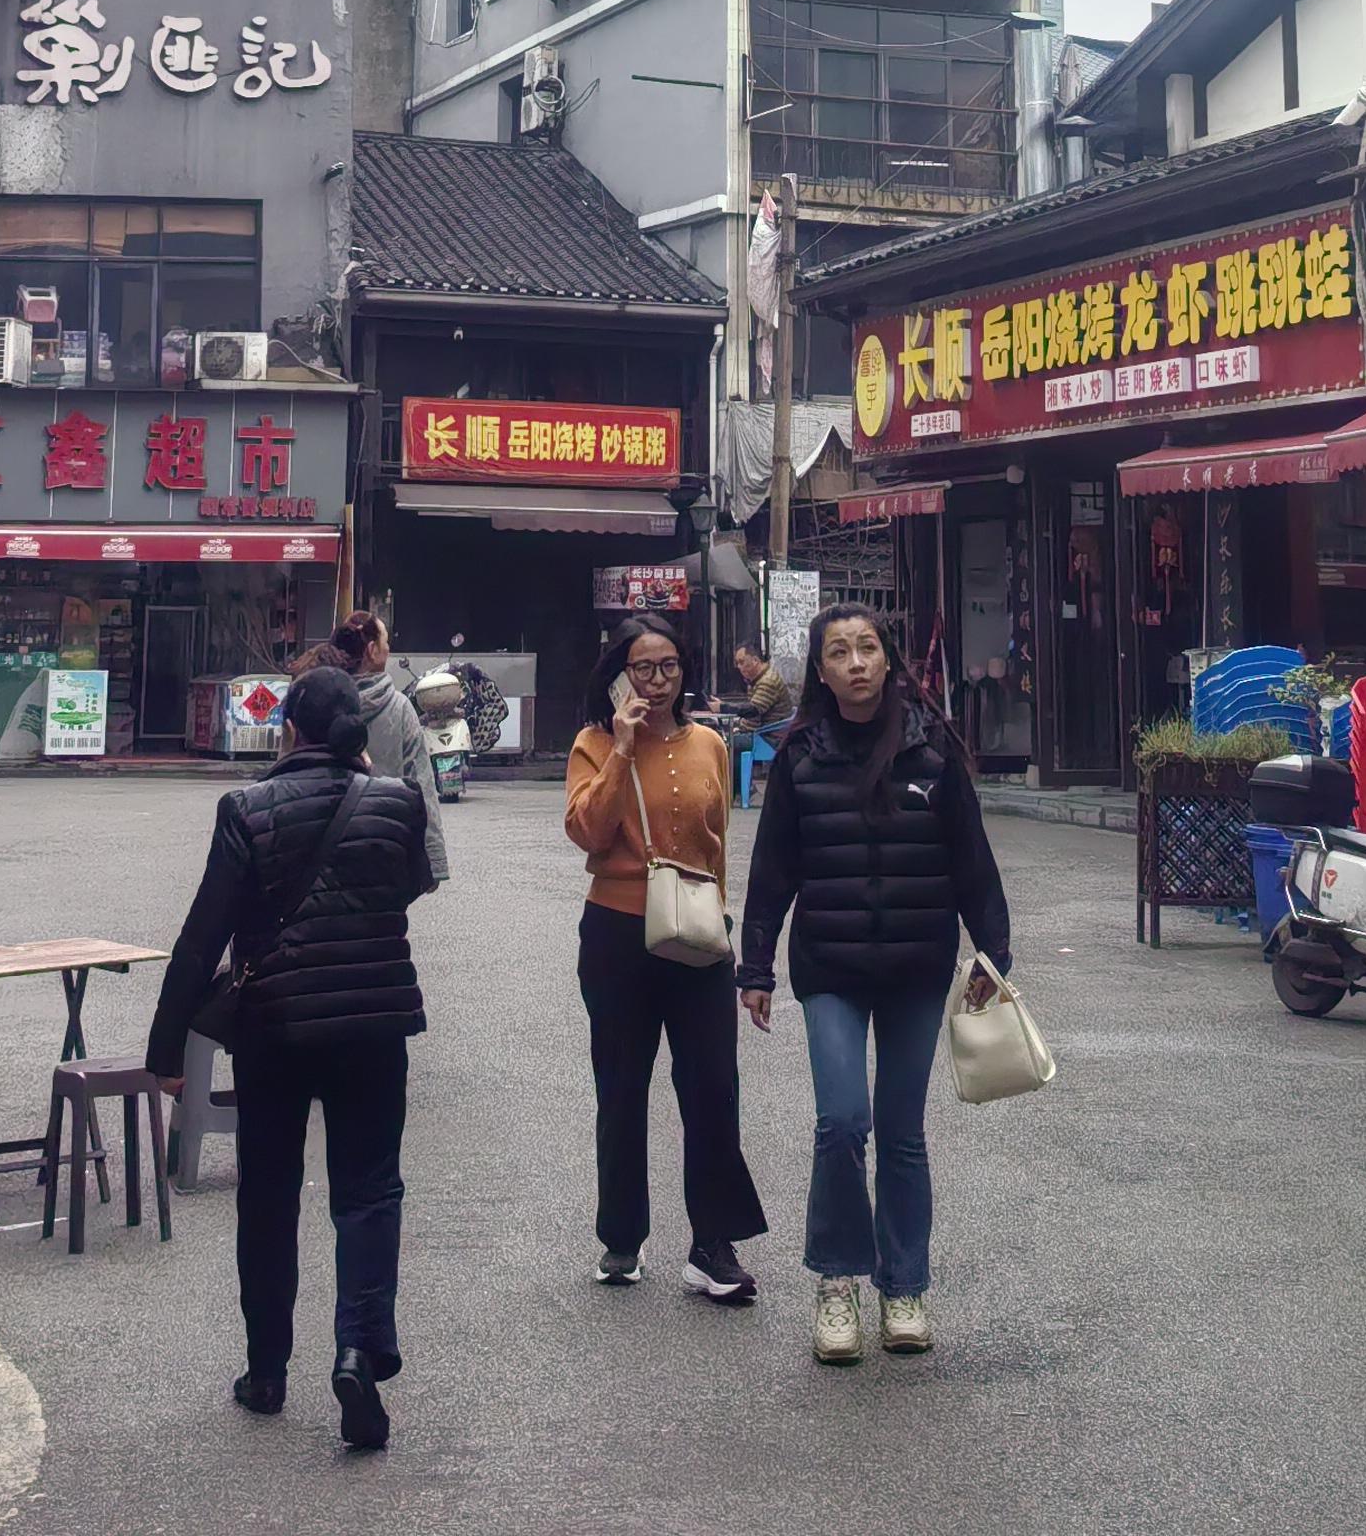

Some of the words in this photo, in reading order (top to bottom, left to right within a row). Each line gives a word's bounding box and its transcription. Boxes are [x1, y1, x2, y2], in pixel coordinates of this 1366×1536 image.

[898, 309, 972, 409] 长顺
[1047, 377, 1103, 407] 湘味小炒
[1117, 362, 1182, 395] 岳阳烧烤
[1198, 345, 1248, 382] 口味虾
[424, 413, 500, 460] 长顺
[507, 420, 596, 464] 岳阳烧烤
[601, 425, 666, 465] 砂锅粥
